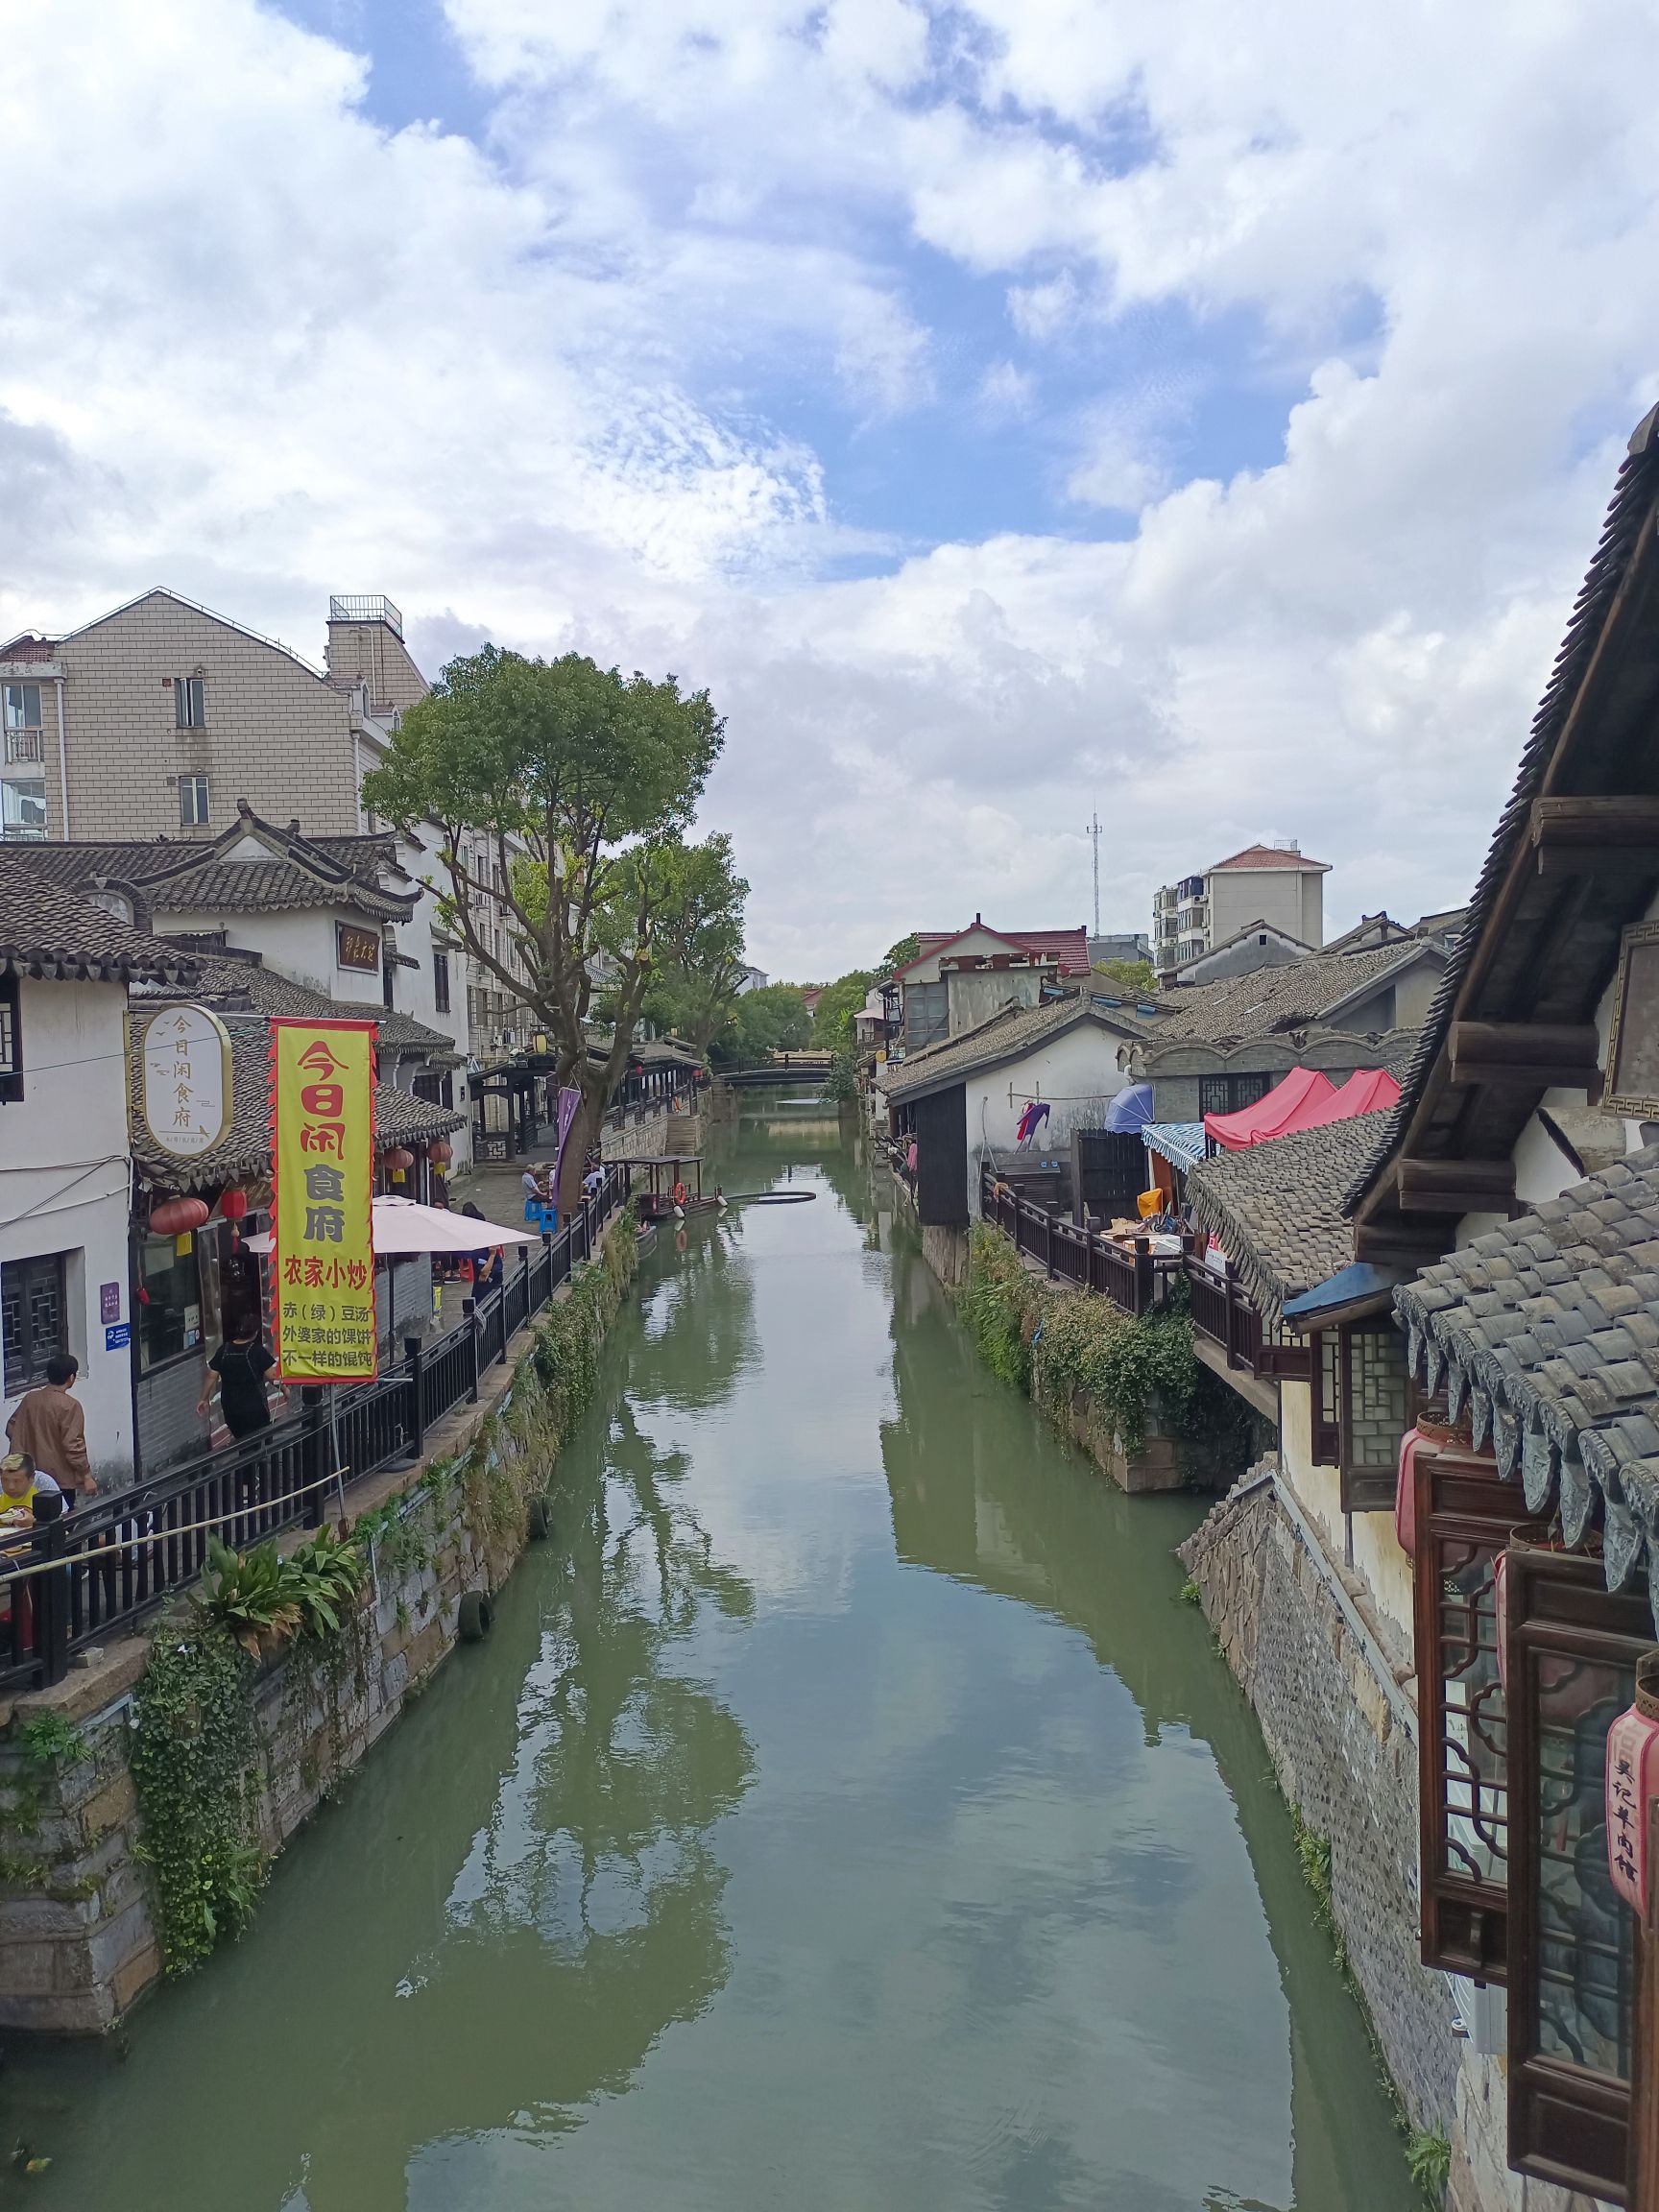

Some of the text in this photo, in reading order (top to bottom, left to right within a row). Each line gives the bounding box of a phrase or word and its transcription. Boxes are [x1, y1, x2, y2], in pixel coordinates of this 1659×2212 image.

[172, 1015, 194, 1128] 今日闲食府
[297, 1040, 349, 1243] 今日闲食府
[283, 1254, 368, 1290] 农家小炒
[282, 1349, 373, 1367] 不一样的馄饨
